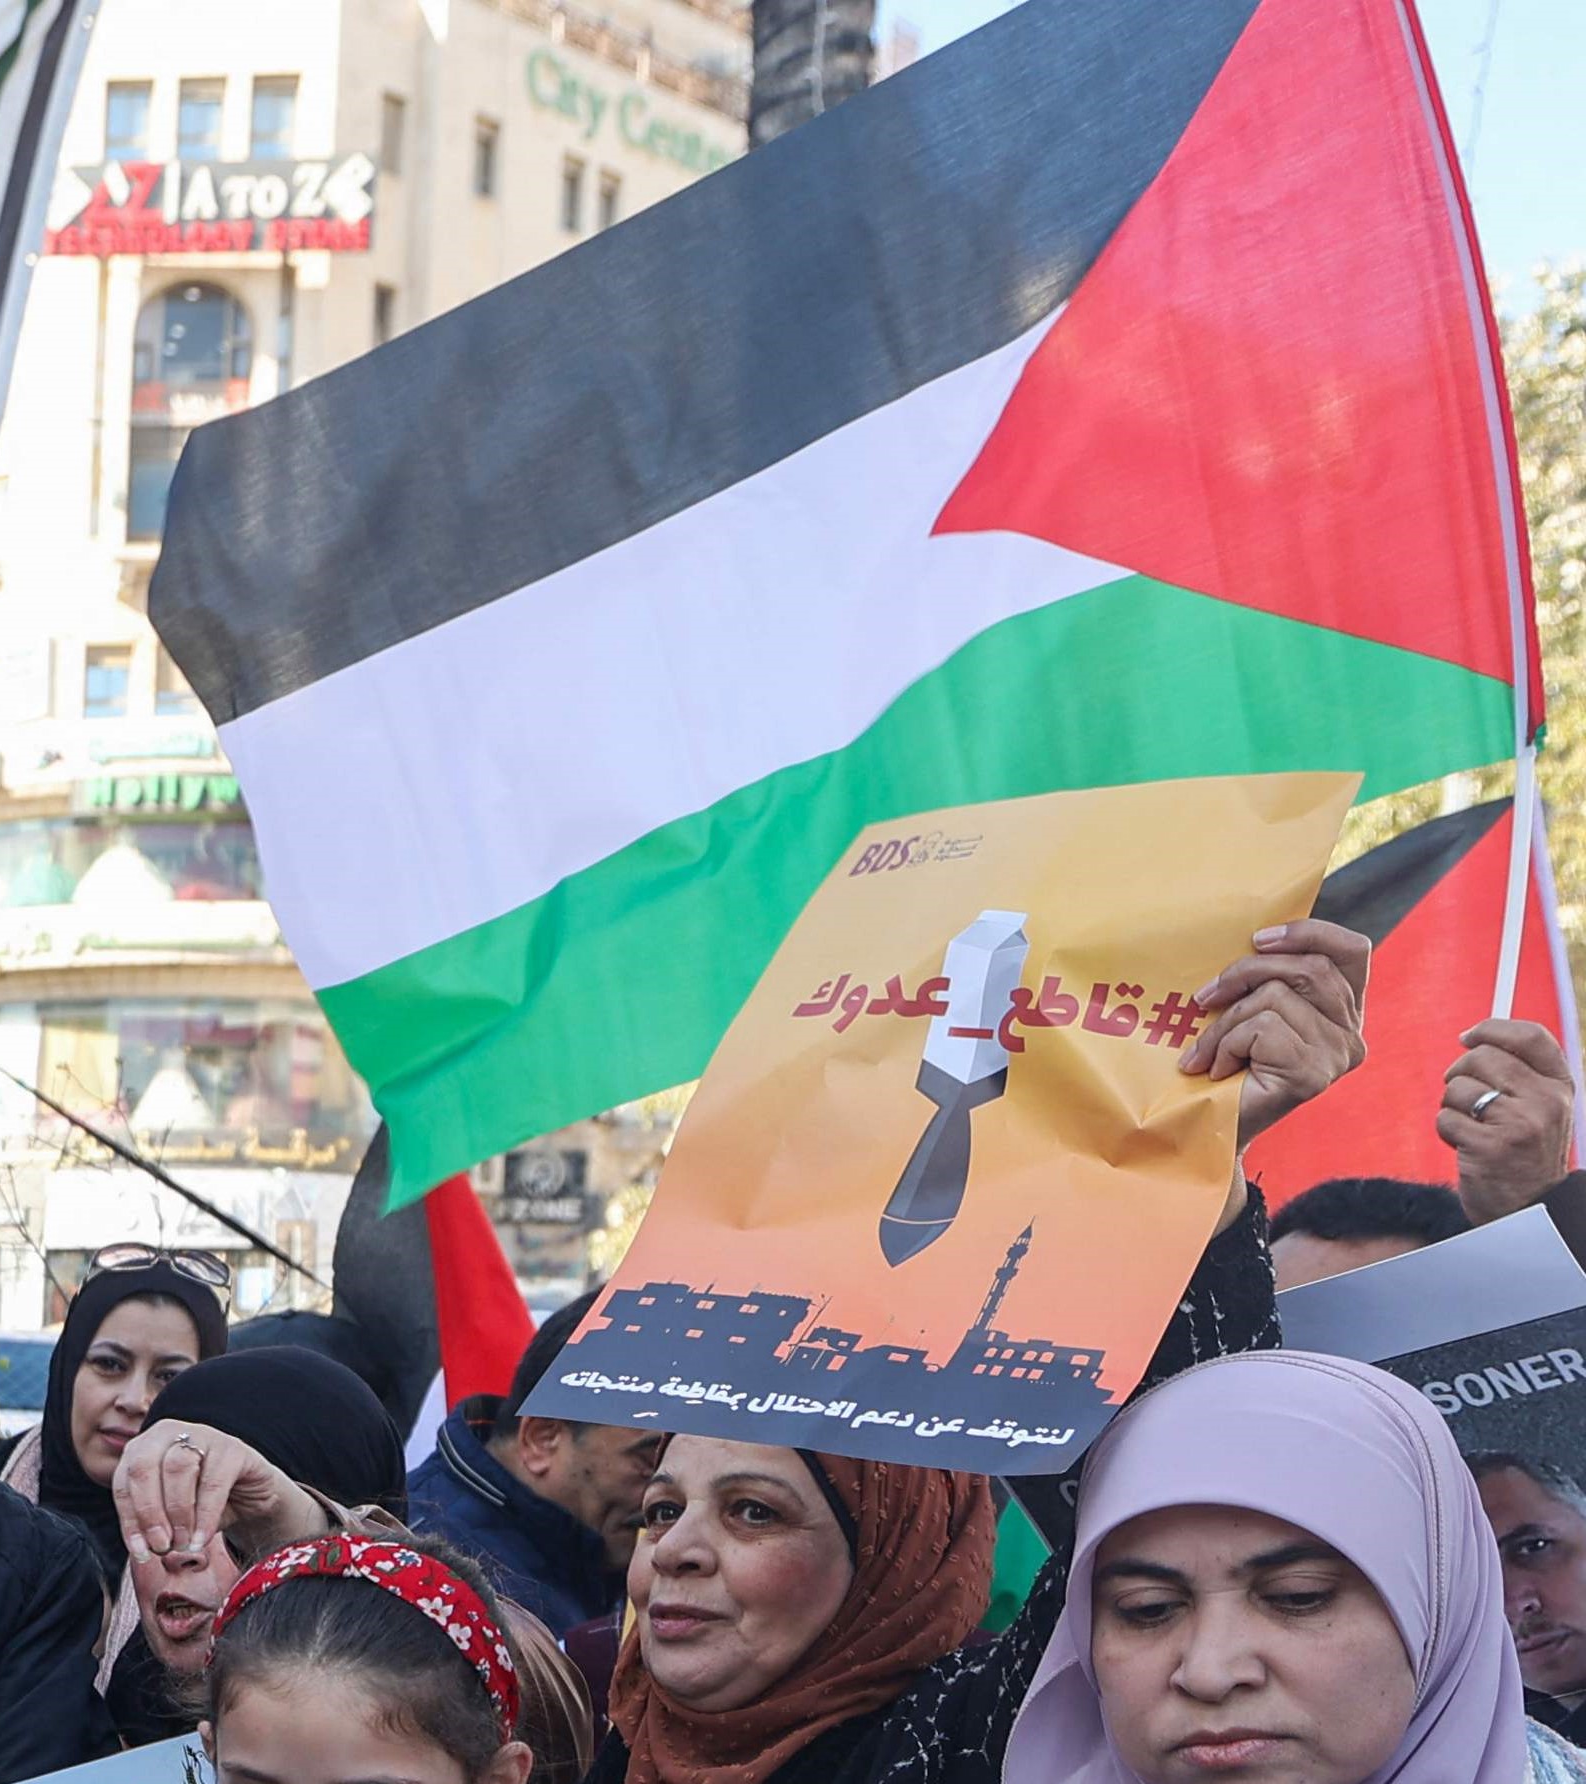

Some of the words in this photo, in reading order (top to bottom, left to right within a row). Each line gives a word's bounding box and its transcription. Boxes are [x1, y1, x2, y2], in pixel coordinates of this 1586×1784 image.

[848, 835, 922, 877] BDS
[559, 1368, 655, 1396] منتجاته
[1423, 1348, 1586, 1415] SONER
[747, 1391, 856, 1421] الاحتلال
[853, 1407, 915, 1436] دعم
[914, 1411, 965, 1438] عن
[964, 1411, 1075, 1449] لنتوقف
